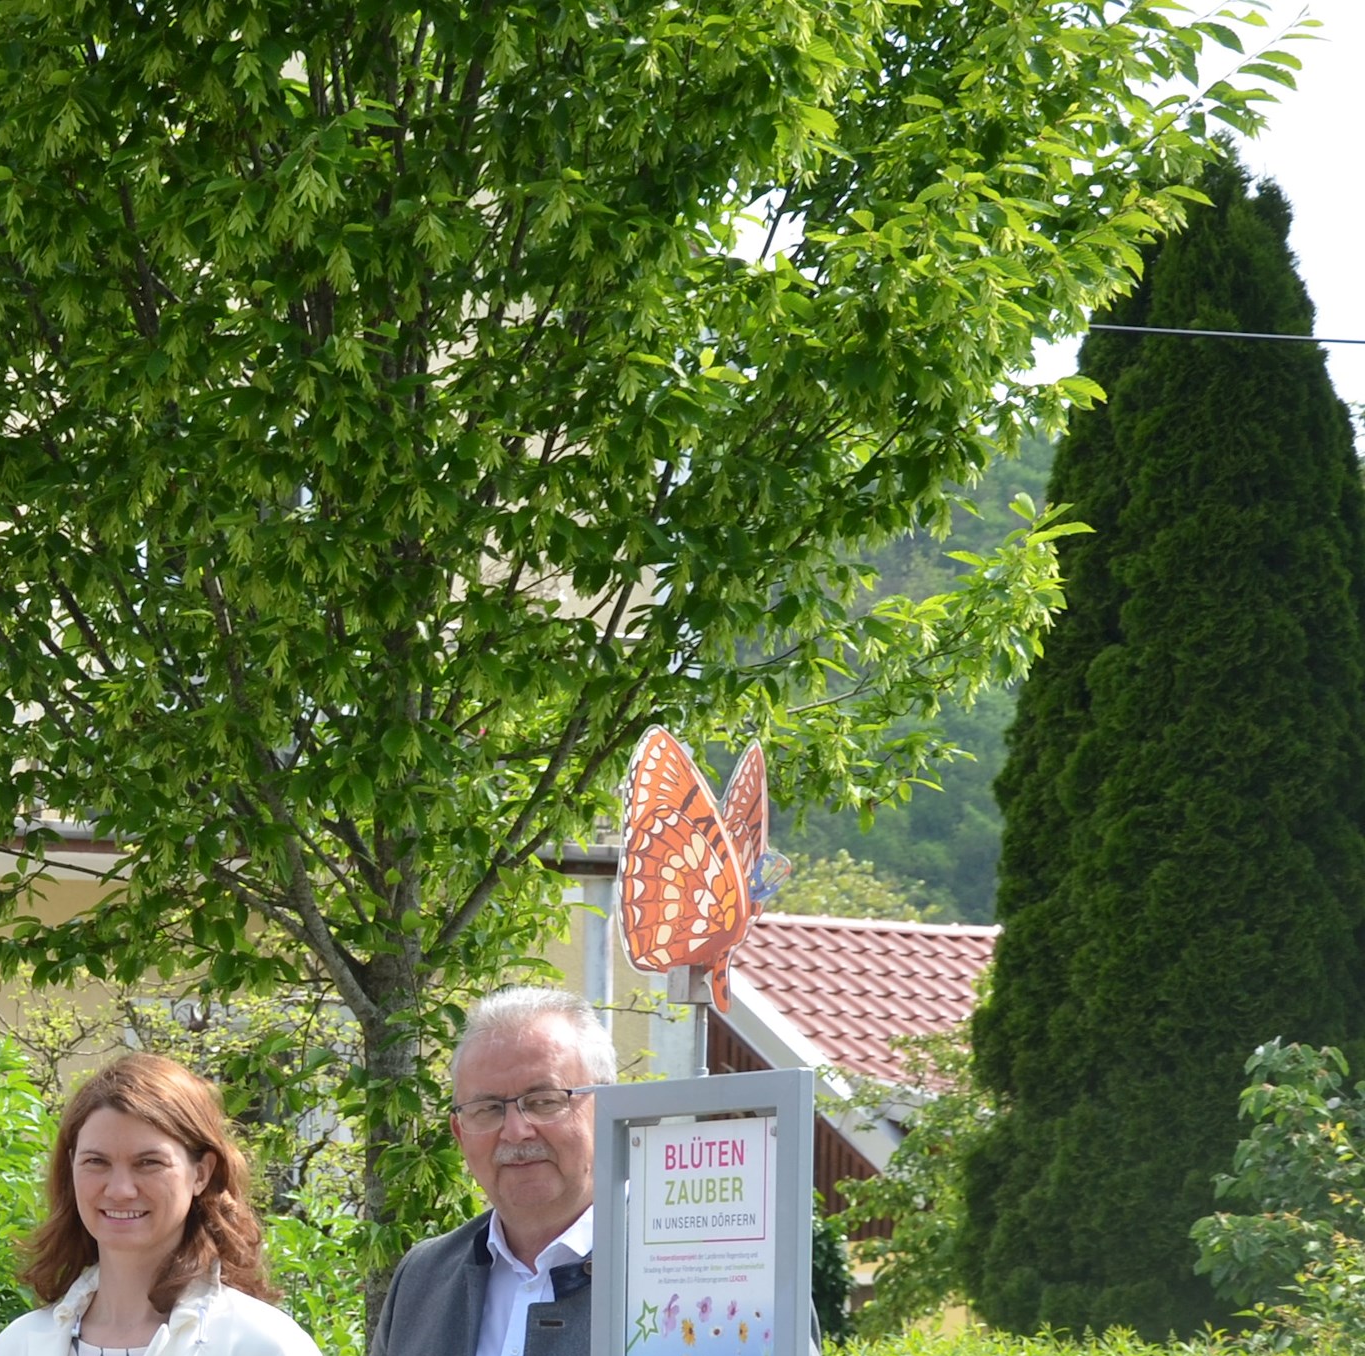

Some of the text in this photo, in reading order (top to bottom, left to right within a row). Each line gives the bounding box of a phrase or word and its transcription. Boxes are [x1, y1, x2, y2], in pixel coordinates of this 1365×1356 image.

[664, 1137, 745, 1170] BLÜTEN
[664, 1176, 744, 1205] ZAUBER
[652, 1212, 756, 1230] IN UNSEREN DÖRFERN
